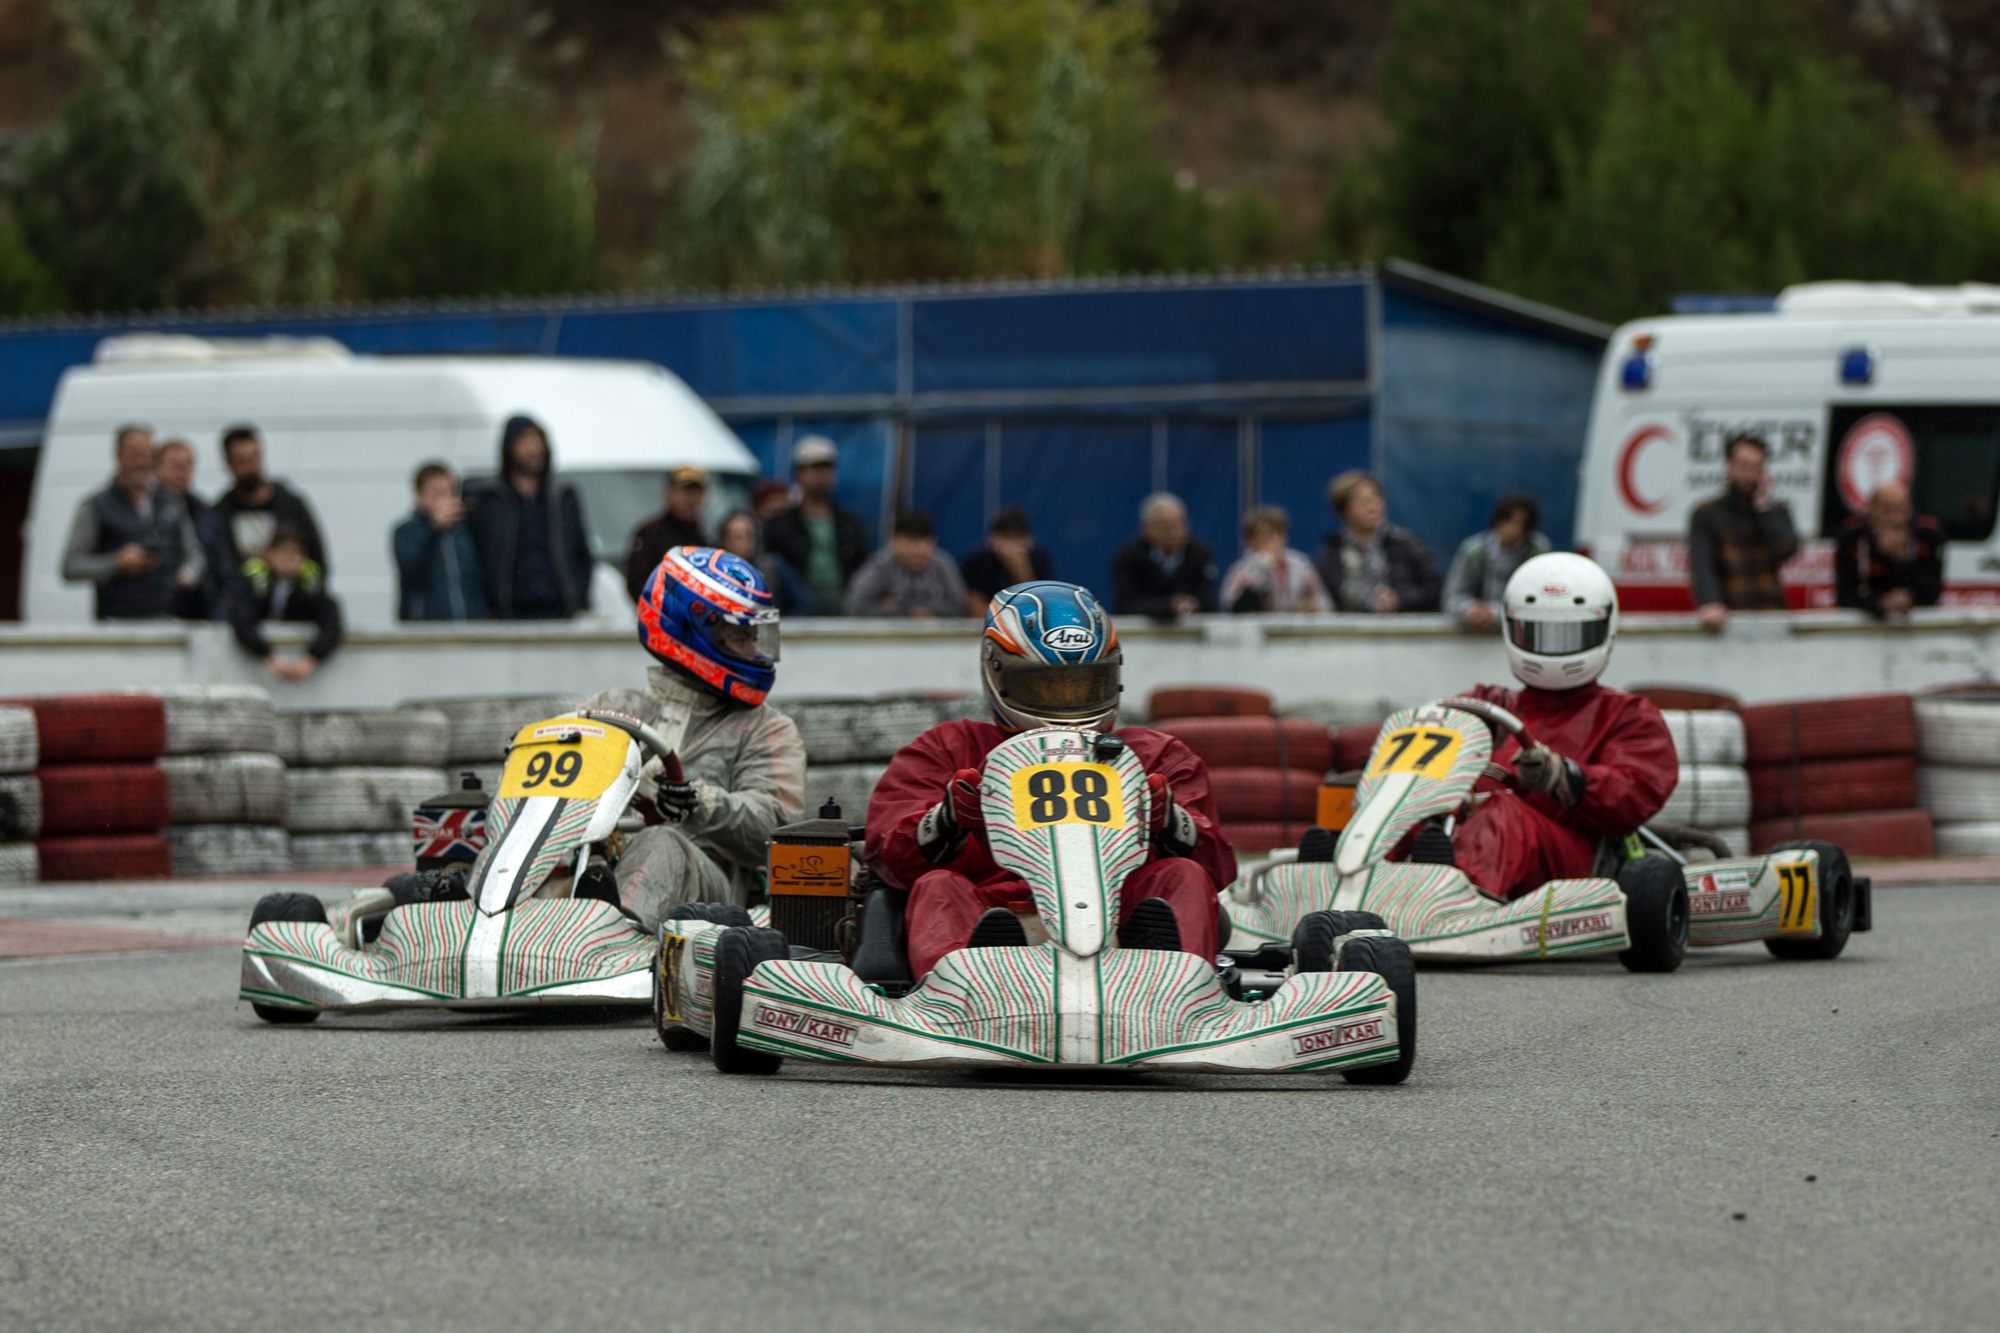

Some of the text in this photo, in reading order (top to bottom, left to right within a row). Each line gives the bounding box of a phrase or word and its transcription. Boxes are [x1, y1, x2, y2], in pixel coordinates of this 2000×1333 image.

[1045, 629, 1090, 645] Arai
[1381, 731, 1453, 770] 77
[522, 751, 582, 788] 99
[1028, 769, 1111, 823] 88
[1779, 866, 1809, 928] 77
[1568, 914, 1608, 932] KART
[760, 1005, 856, 1042] TONY KART
[1292, 1019, 1382, 1051] TONY KART
